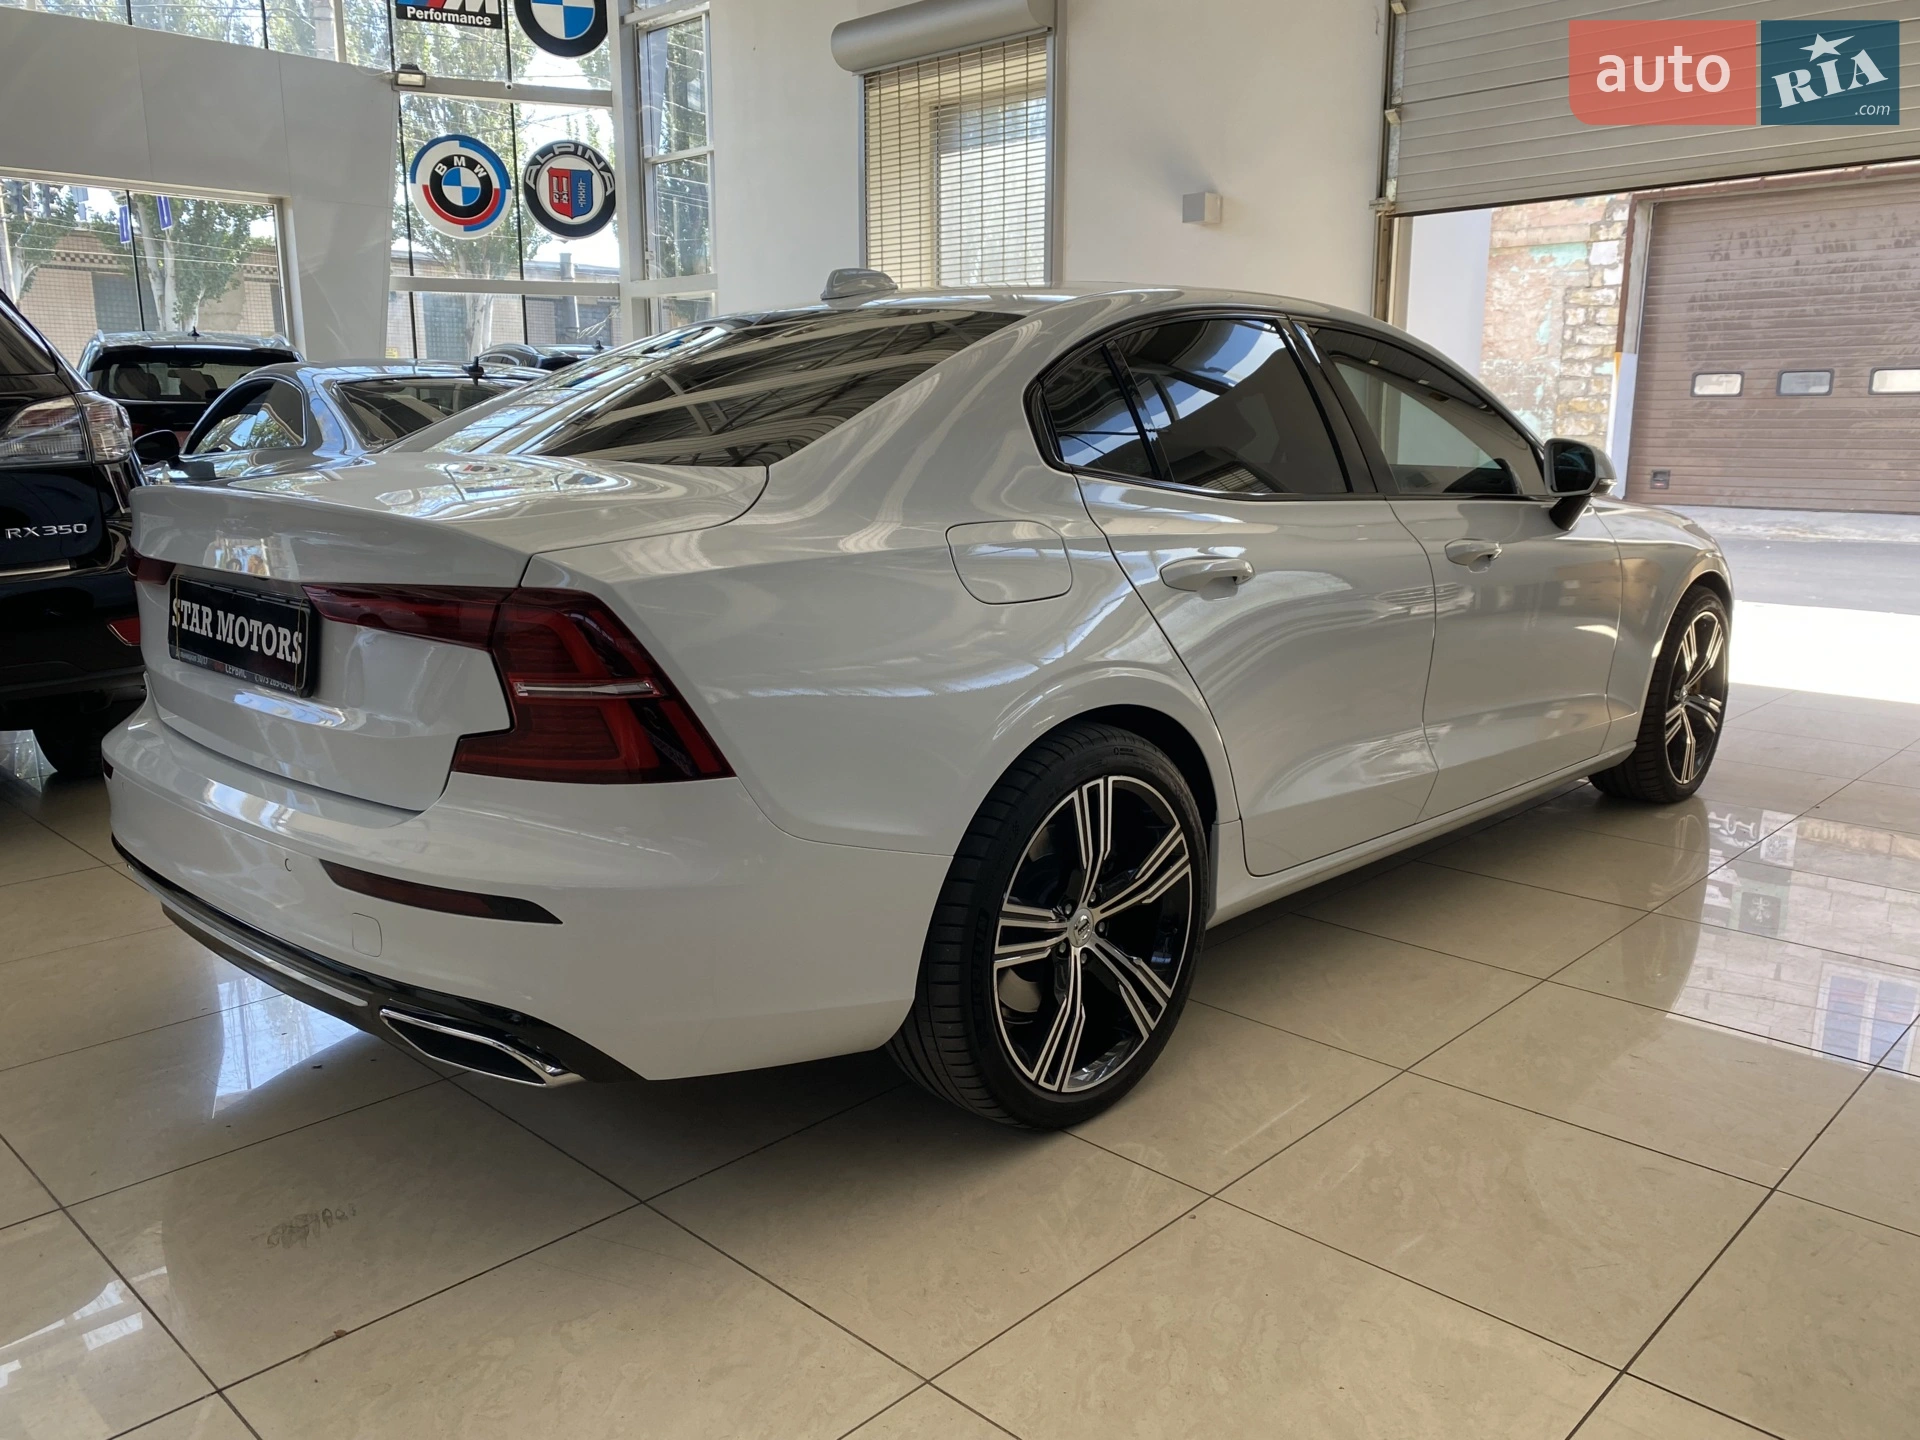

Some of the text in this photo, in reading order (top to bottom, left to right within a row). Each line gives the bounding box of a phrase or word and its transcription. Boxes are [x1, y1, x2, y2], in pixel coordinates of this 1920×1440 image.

[406, 5, 492, 26] Performance
[434, 155, 488, 178] BMW
[525, 142, 616, 197] ALPINA
[4, 523, 88, 540] RX 350
[172, 597, 302, 665] STAR MOTORS
